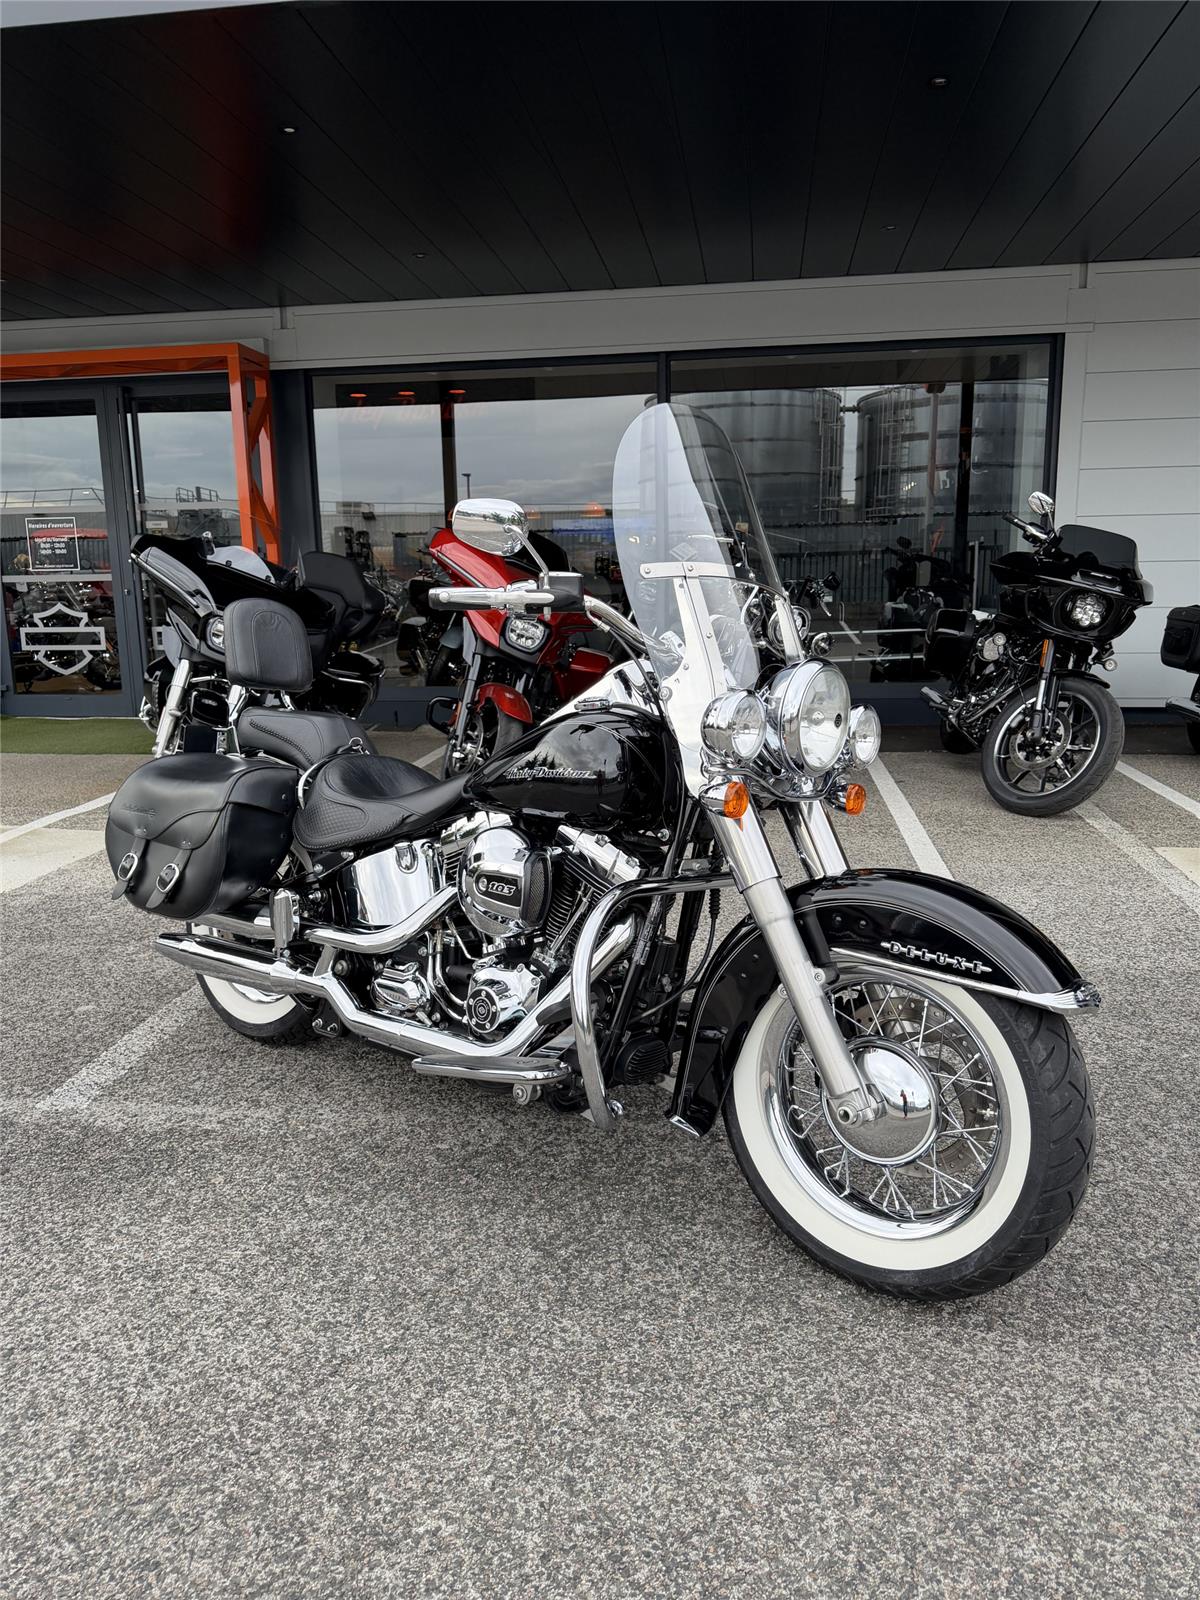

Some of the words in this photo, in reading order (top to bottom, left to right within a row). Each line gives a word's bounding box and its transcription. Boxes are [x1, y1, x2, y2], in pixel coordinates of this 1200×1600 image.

[503, 766, 597, 781] Harley-Davidson
[488, 881, 517, 897] 103
[887, 940, 984, 975] DELUXE
